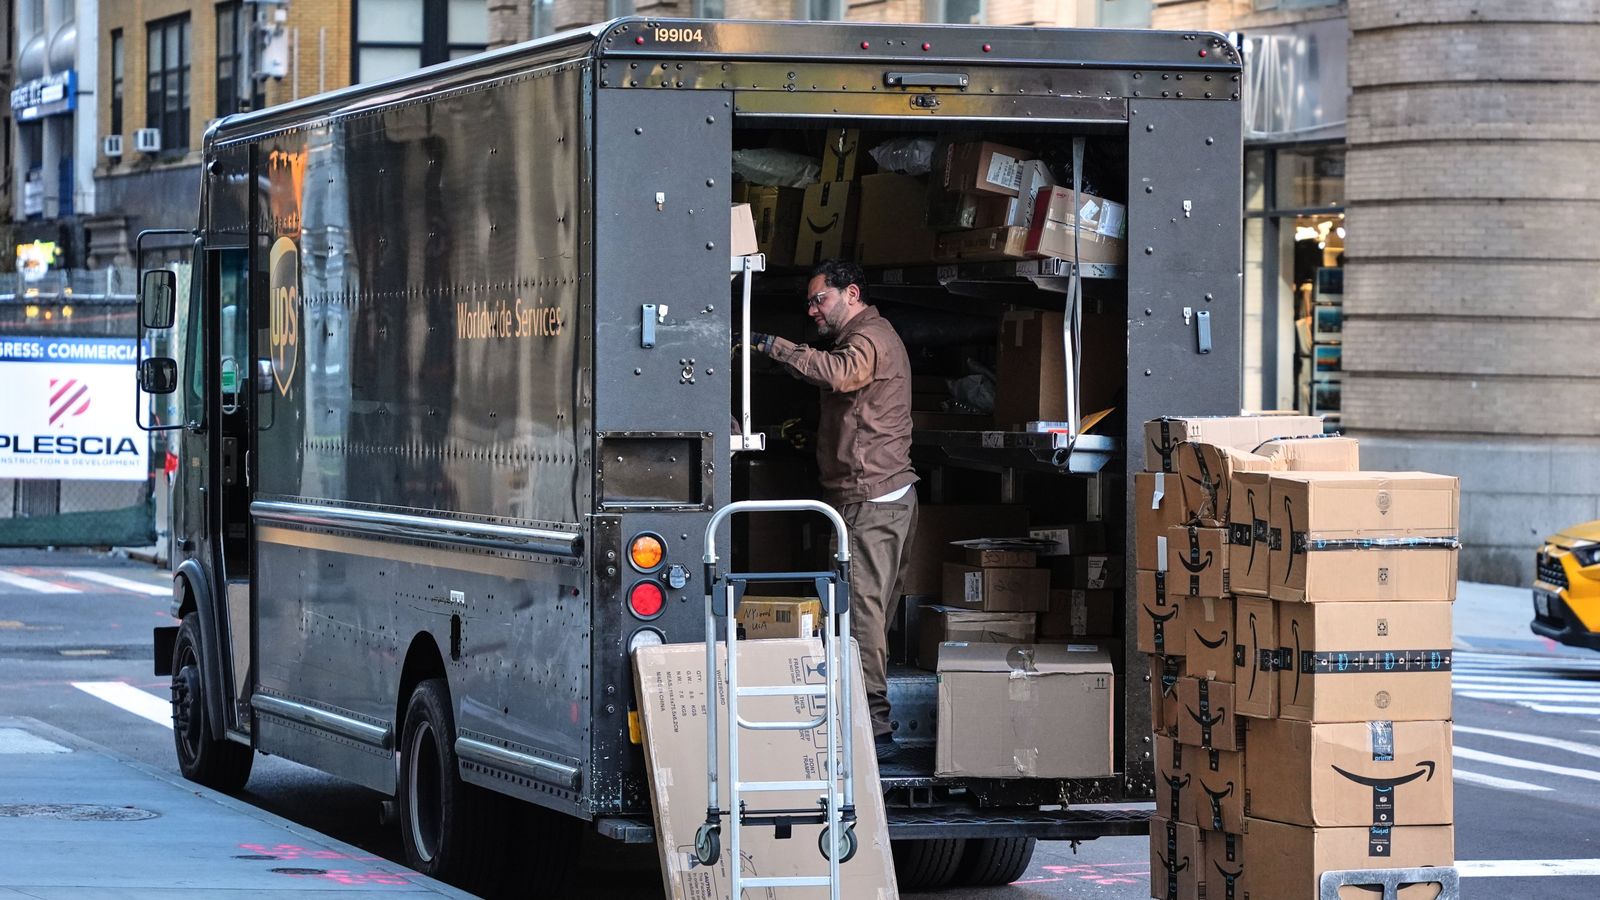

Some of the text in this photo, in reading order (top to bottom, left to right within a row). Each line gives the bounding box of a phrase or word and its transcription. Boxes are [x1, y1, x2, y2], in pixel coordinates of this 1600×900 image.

[655, 28, 703, 42] 199104
[272, 286, 296, 370] ups
[457, 297, 561, 339] Worldwide Services
[48, 343, 149, 360] COMMERCIAL
[793, 657, 801, 682] FRAGILE
[716, 669, 726, 706] WHITEBOARD
